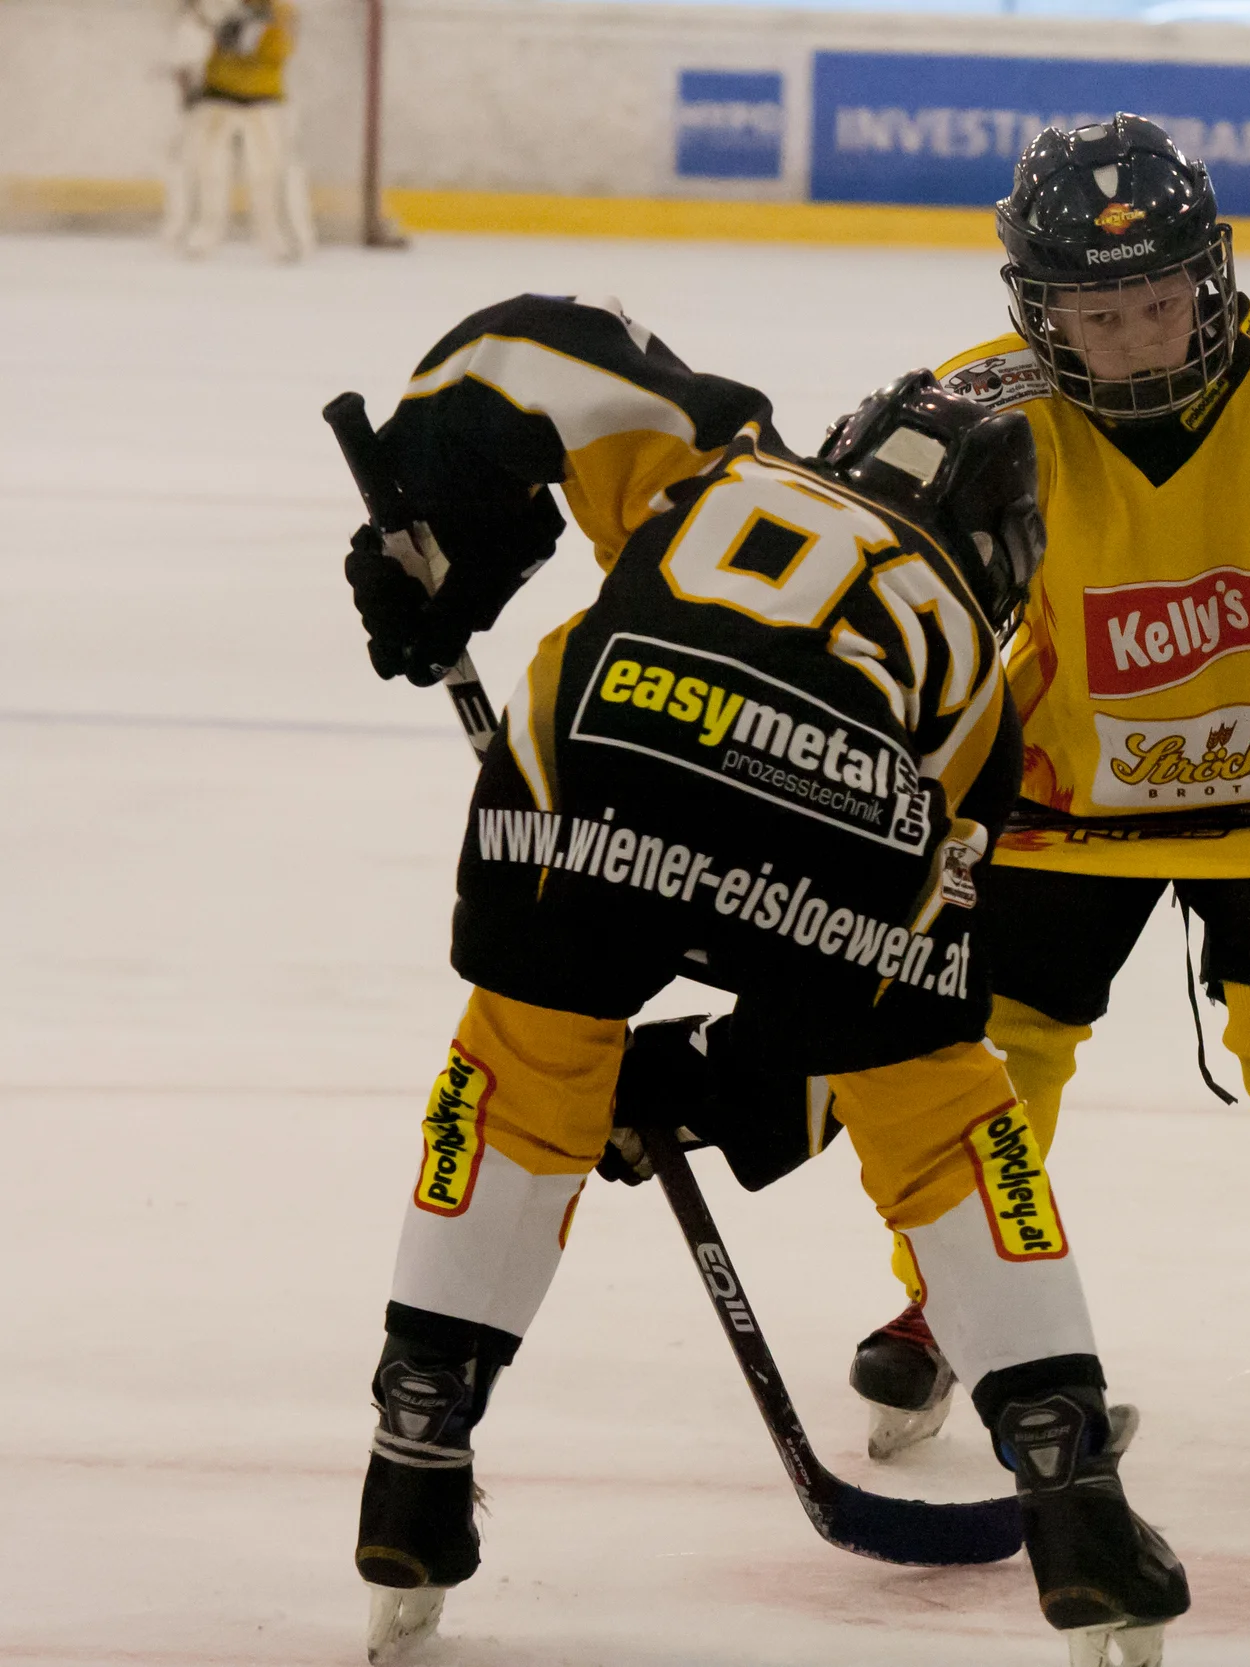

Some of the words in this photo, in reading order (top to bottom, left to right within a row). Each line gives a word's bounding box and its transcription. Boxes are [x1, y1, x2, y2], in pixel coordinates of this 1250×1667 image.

[1085, 238, 1157, 266] Reebok
[1106, 579, 1250, 672] Kelly's
[599, 658, 891, 799] easymetal
[720, 748, 885, 826] prozesstechnik
[1148, 784, 1242, 799] BROT
[477, 806, 971, 1001] www.wiener-eisloewen.at
[987, 1112, 1053, 1251] ohockey.at
